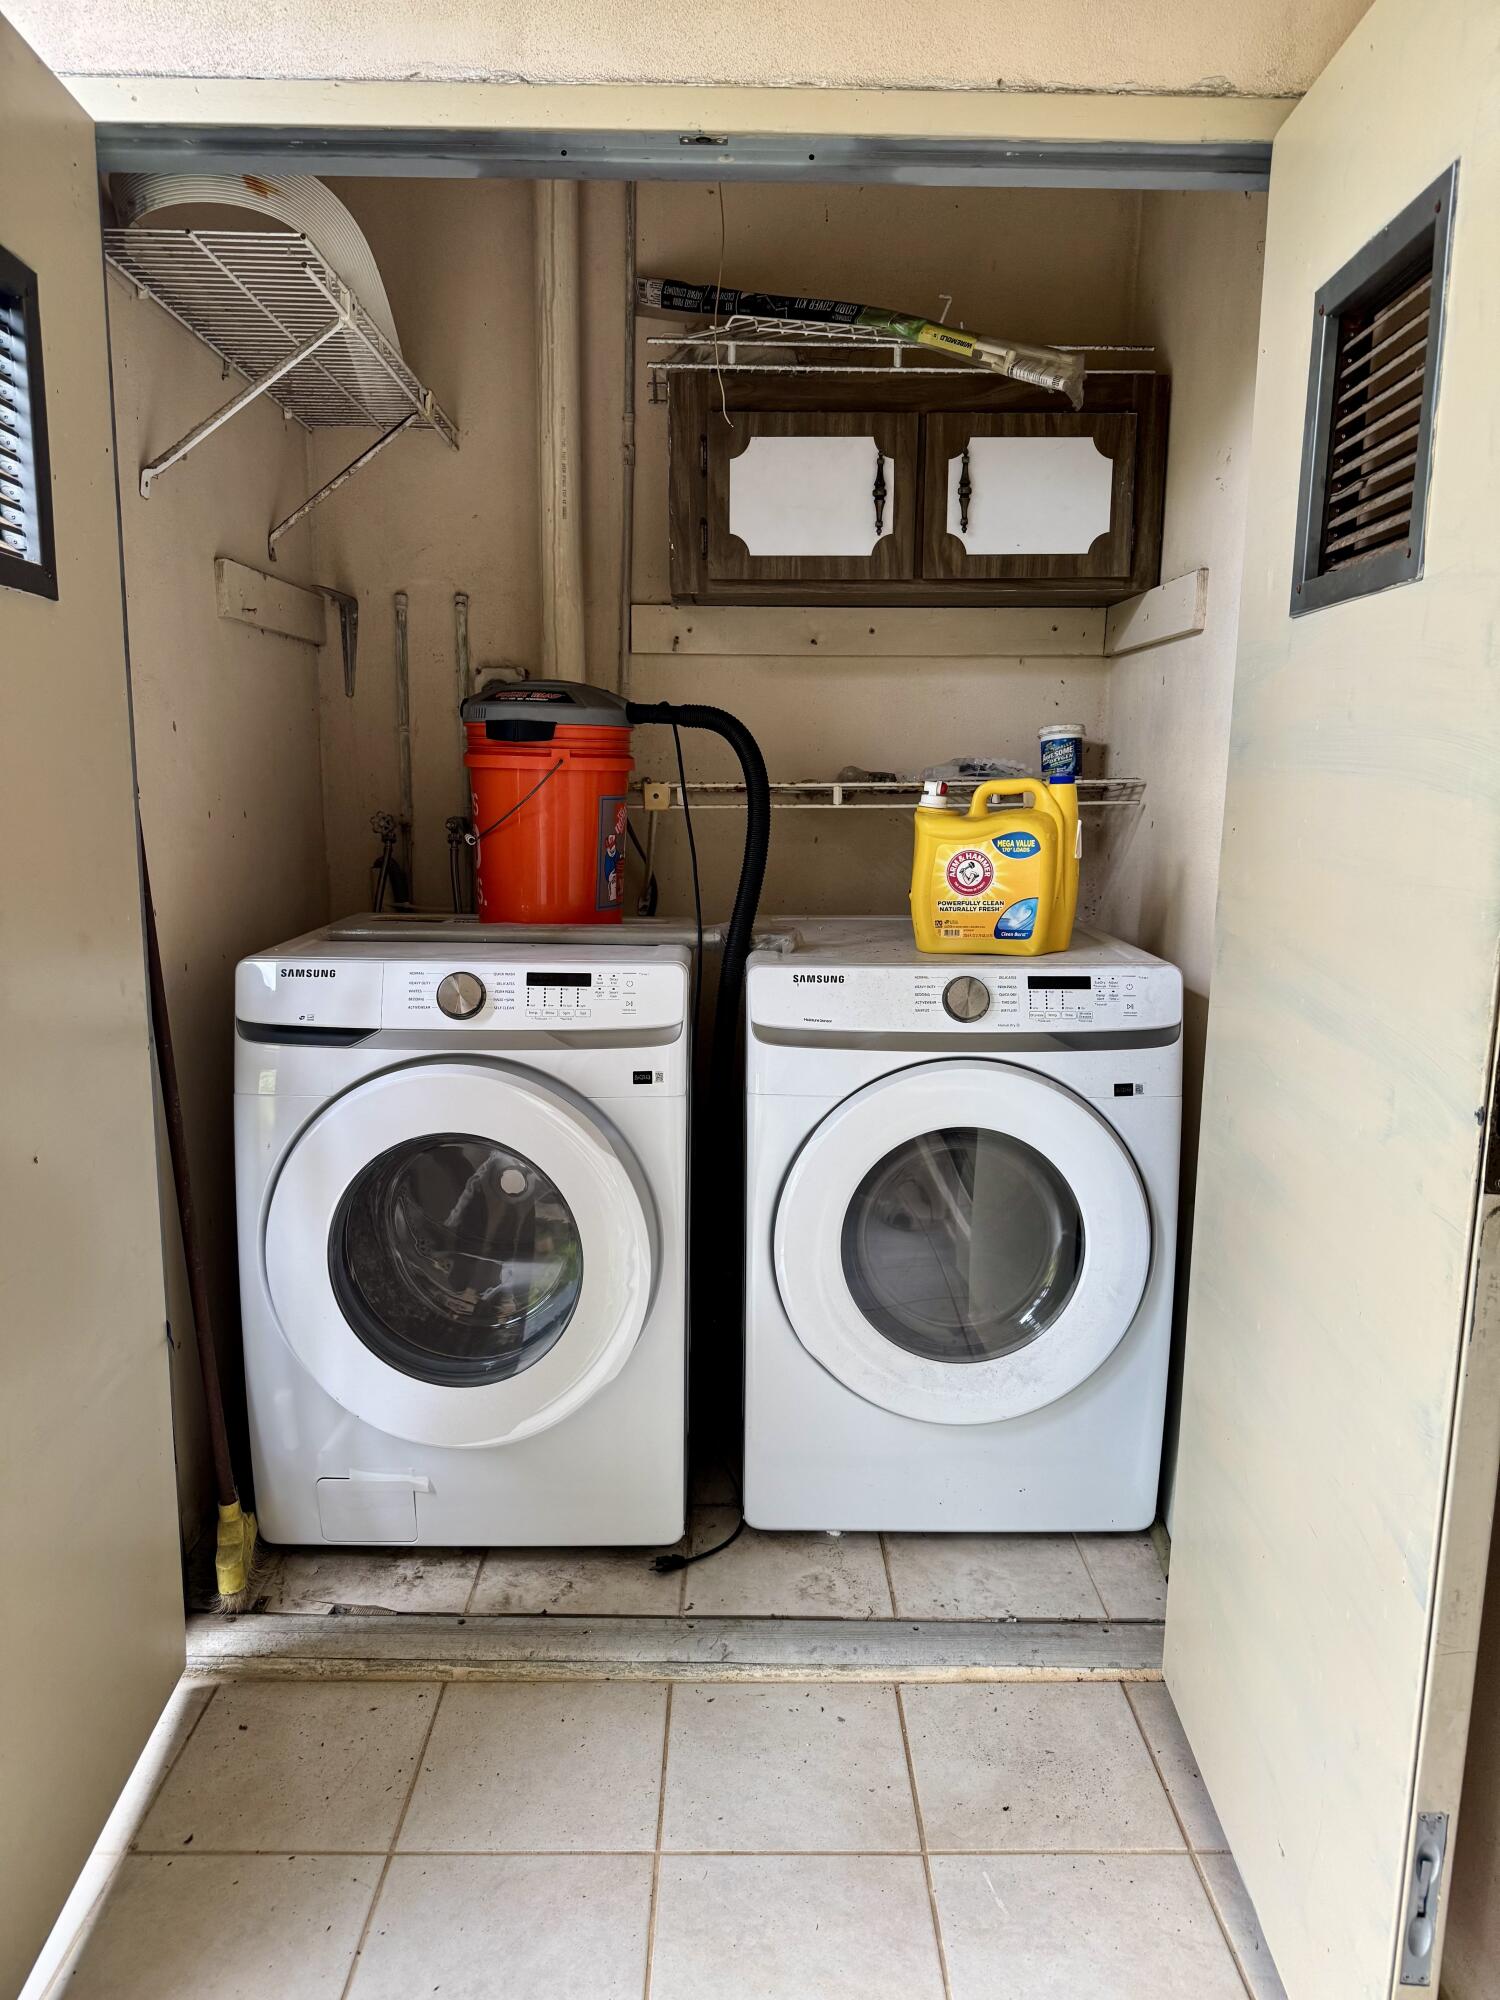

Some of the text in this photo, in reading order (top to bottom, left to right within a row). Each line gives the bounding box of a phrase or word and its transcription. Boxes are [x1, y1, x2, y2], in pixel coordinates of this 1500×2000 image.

[794, 298, 857, 316] CORD COVER KIT
[940, 334, 972, 349] WIREMOLD
[1042, 745, 1074, 762] AWESOME
[998, 840, 1036, 848] MEGA VALUE
[950, 860, 960, 878] ARM
[966, 852, 991, 877] HAMMER
[280, 968, 336, 978] SAMSUNG
[792, 974, 845, 983] SAMSUNG
